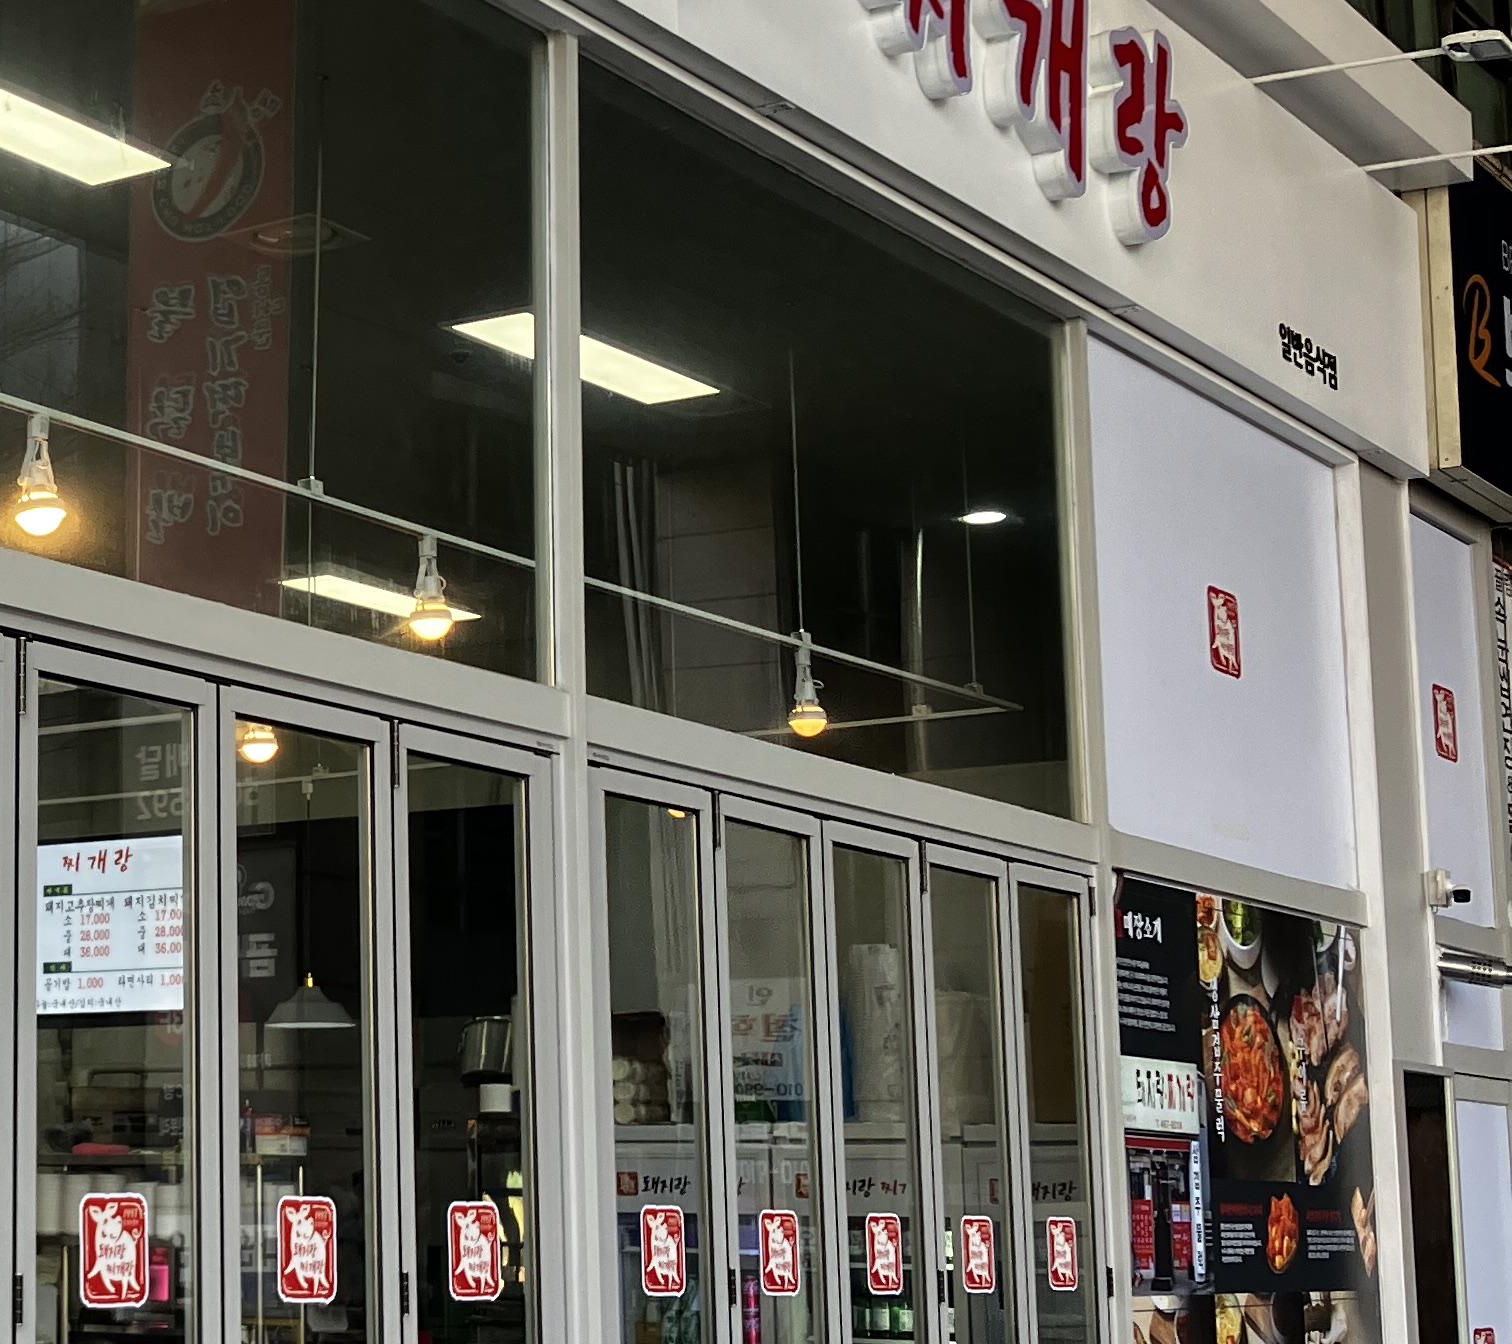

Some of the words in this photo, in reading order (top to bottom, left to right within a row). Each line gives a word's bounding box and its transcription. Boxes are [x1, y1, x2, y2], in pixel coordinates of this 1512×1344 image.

[1279, 323, 1338, 390] 일반음식점
[63, 847, 133, 874] 찌개랑
[124, 893, 182, 910] 돼지김치찌
[98, 1246, 127, 1262] 돼지랑
[106, 1262, 135, 1277] 찌개랑
